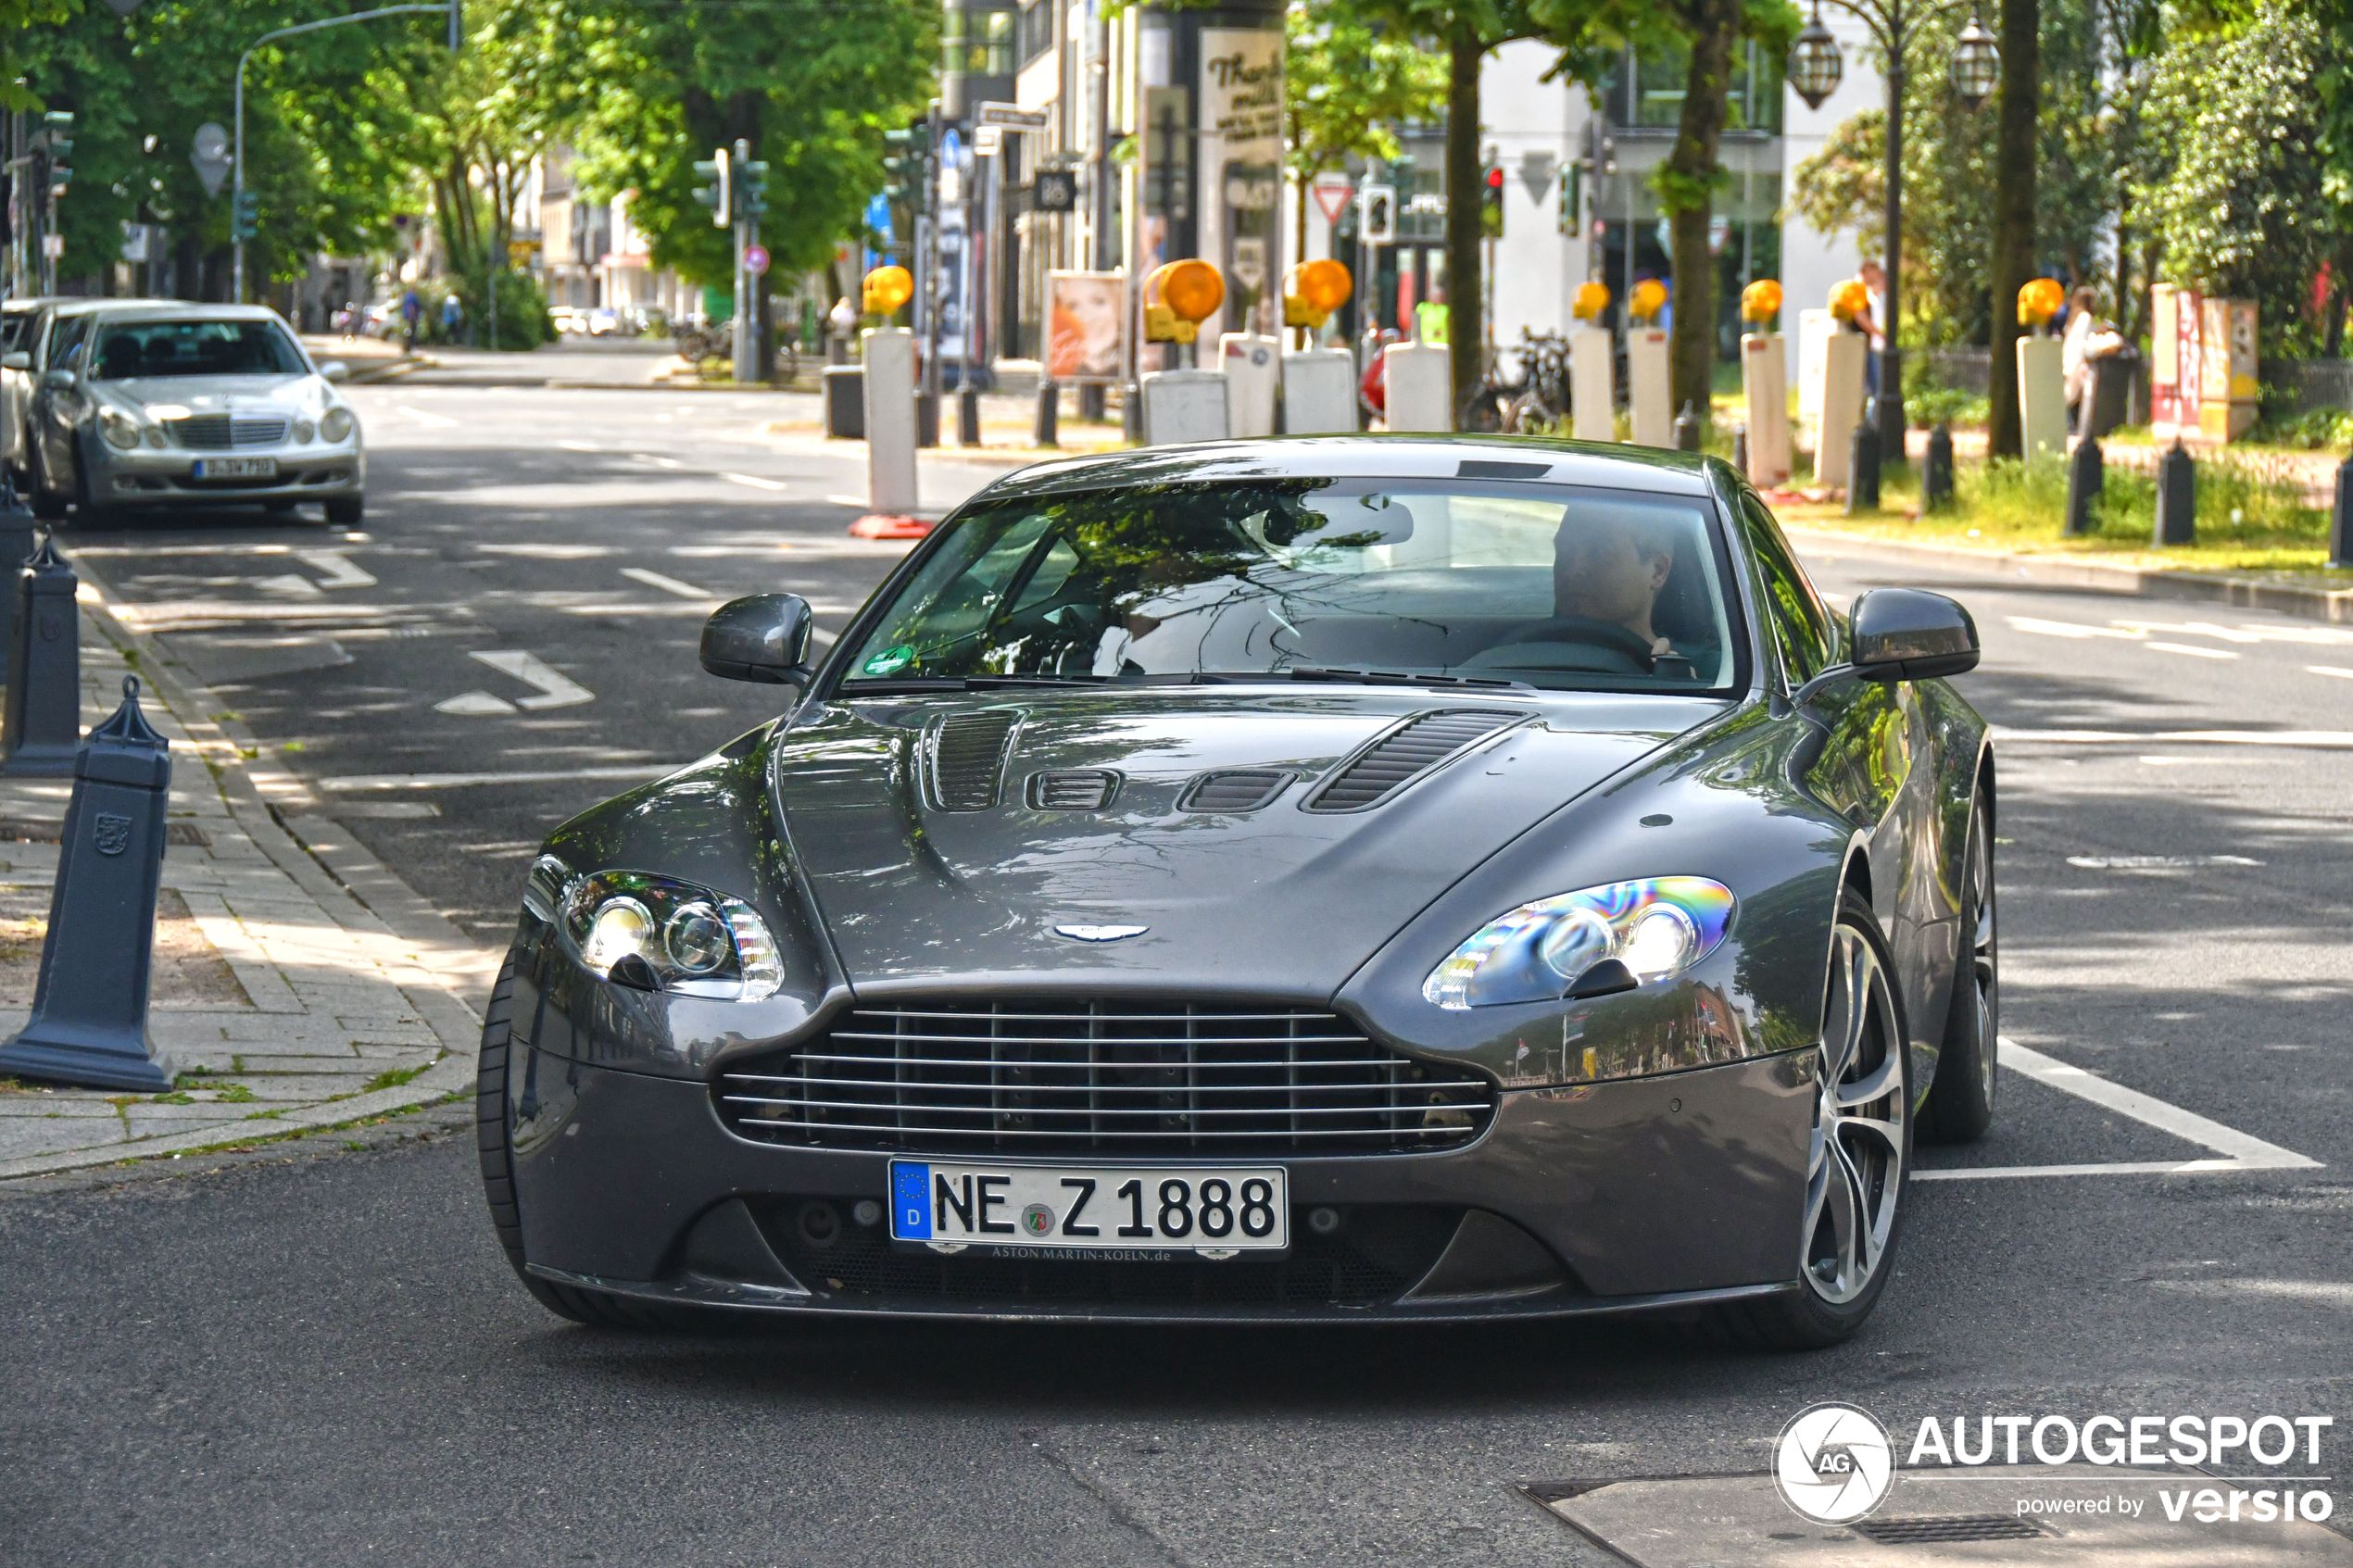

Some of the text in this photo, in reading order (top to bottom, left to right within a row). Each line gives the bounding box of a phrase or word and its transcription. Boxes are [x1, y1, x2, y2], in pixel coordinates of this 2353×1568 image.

[935, 1173, 1015, 1234] NE
[1060, 1177, 1100, 1236] Z
[1117, 1177, 1276, 1238] 1888
[907, 1209, 920, 1225] D
[992, 1246, 1171, 1261] ASTON MARTIN-KOELN.de
